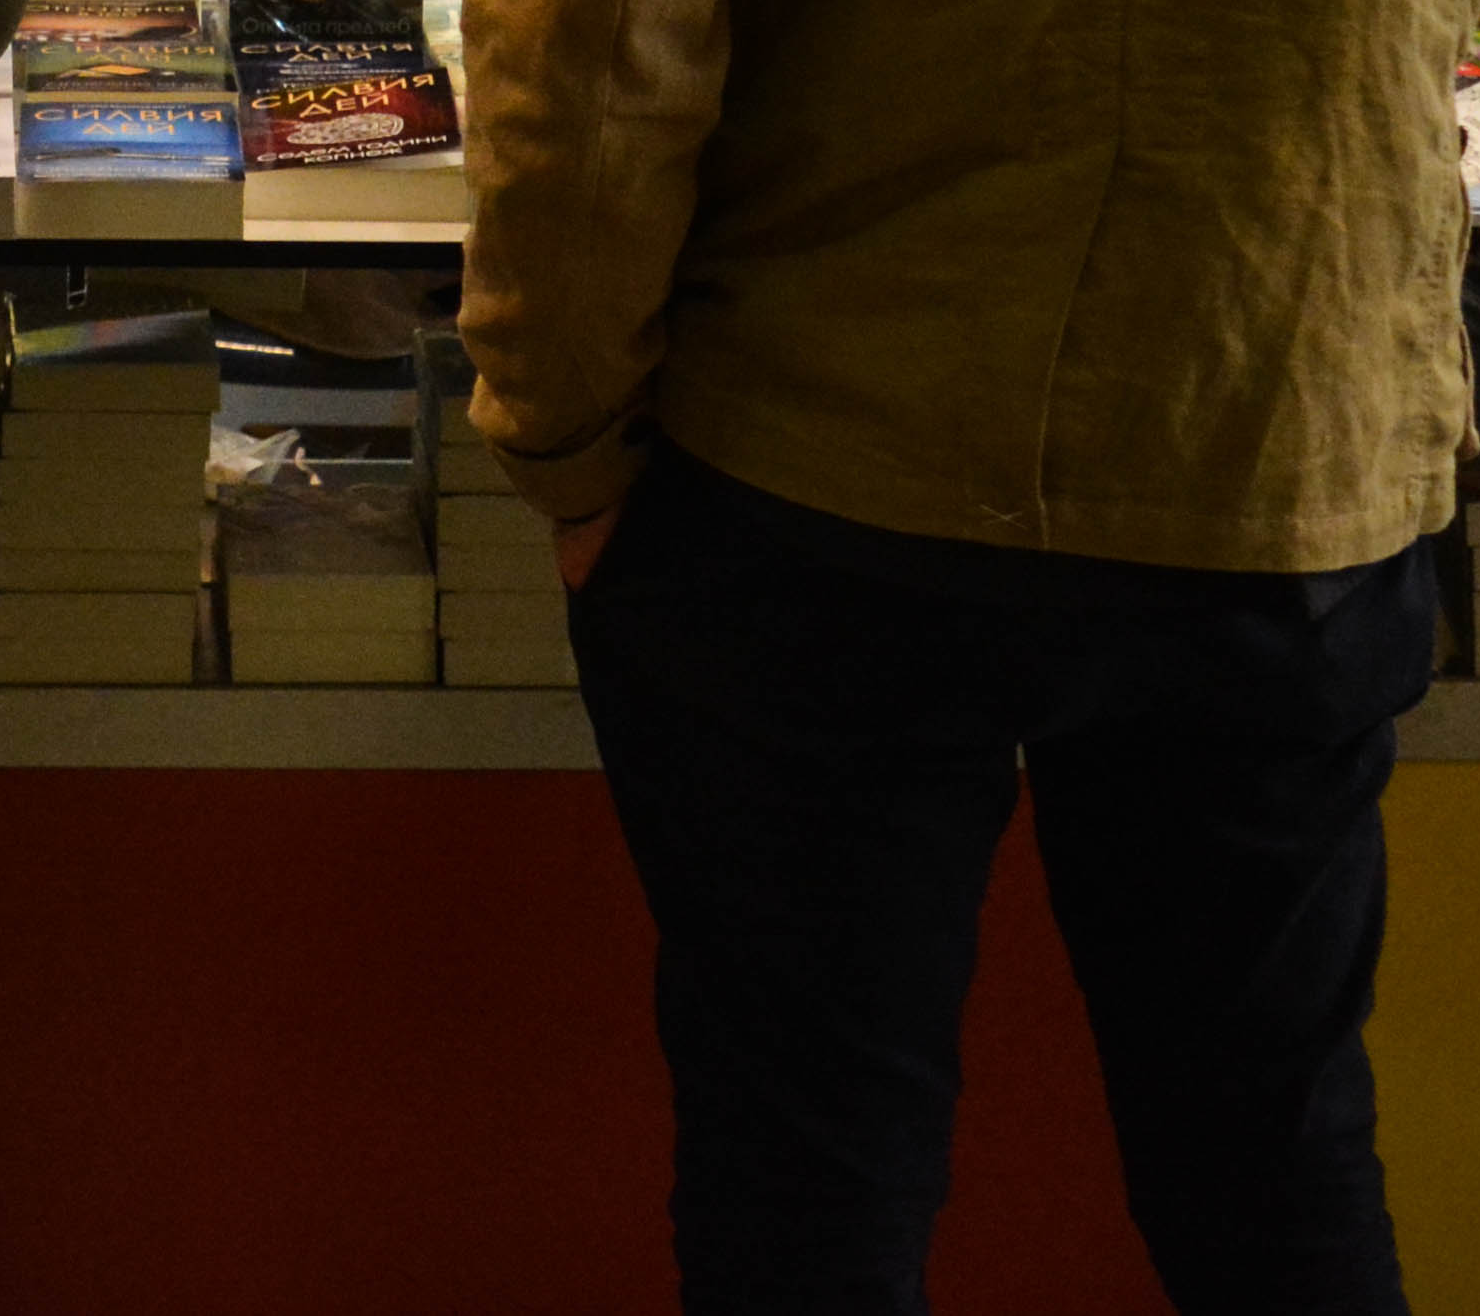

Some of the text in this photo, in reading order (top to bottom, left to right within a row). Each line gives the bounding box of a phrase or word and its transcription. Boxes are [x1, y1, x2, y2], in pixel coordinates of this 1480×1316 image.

[241, 43, 413, 54] СИЛВИЯ
[251, 73, 437, 111] СИЛВИЯ
[299, 94, 389, 119] ДЕЙ
[34, 109, 223, 122] СИЛВИЯ
[83, 121, 176, 136] ДЕЙ
